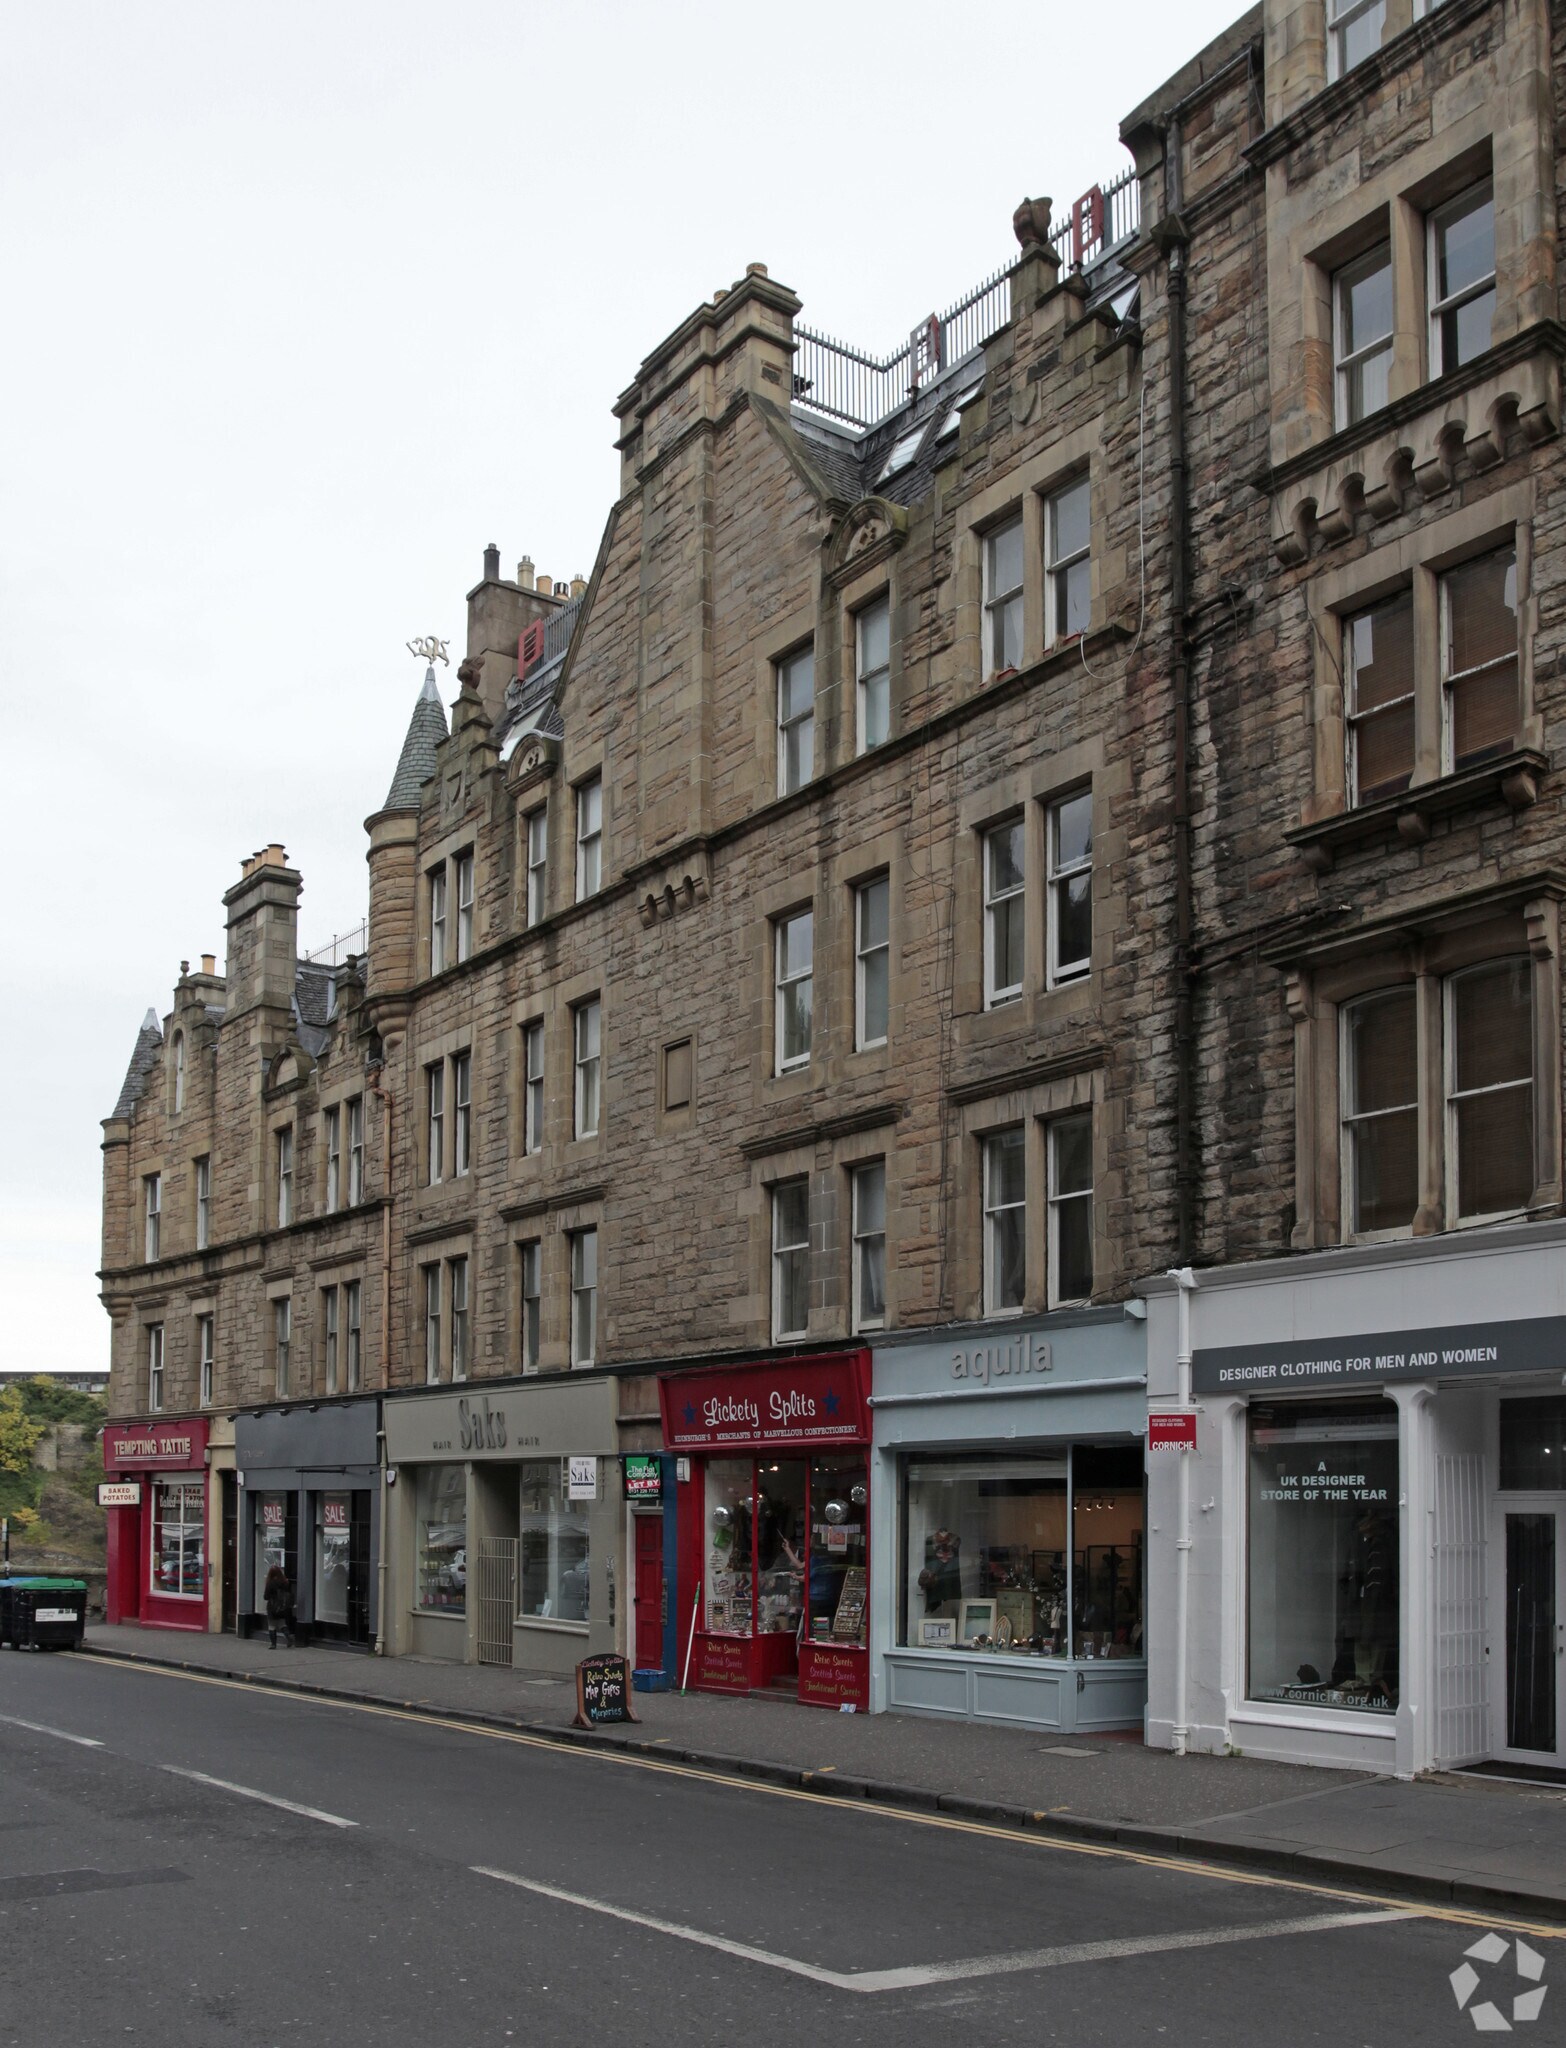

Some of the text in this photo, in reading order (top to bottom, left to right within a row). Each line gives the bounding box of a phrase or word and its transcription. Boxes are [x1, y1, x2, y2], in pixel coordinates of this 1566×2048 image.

[951, 1333, 1053, 1386] aquila
[1219, 1347, 1497, 1381] DESIGNER CLOTHING FOR MEN AND WOMEN
[703, 1390, 816, 1427] Lickety Splits
[459, 1396, 507, 1450] Saks
[717, 1431, 751, 1440] MERCHANTS
[764, 1429, 803, 1438] MARVELLOUS
[805, 1425, 857, 1436] CONFECTIONERY
[114, 1438, 191, 1455] TEMPTING TATTIE
[1152, 1441, 1194, 1450] CORNICHE
[1317, 1461, 1327, 1471] A
[571, 1467, 595, 1481] Saks
[627, 1470, 658, 1479] Company
[1280, 1475, 1366, 1486] UK DESIGNER
[628, 1479, 659, 1489] LET BY
[1260, 1489, 1387, 1500] STORE OF THE YEAR
[264, 1505, 282, 1522] SALE
[324, 1505, 345, 1523] SALE
[814, 1652, 853, 1667] Retro Sweets
[587, 1668, 624, 1684] Retro Sweets
[600, 1696, 607, 1708] &
[1258, 1686, 1389, 1708] www.corniche.org.uk
